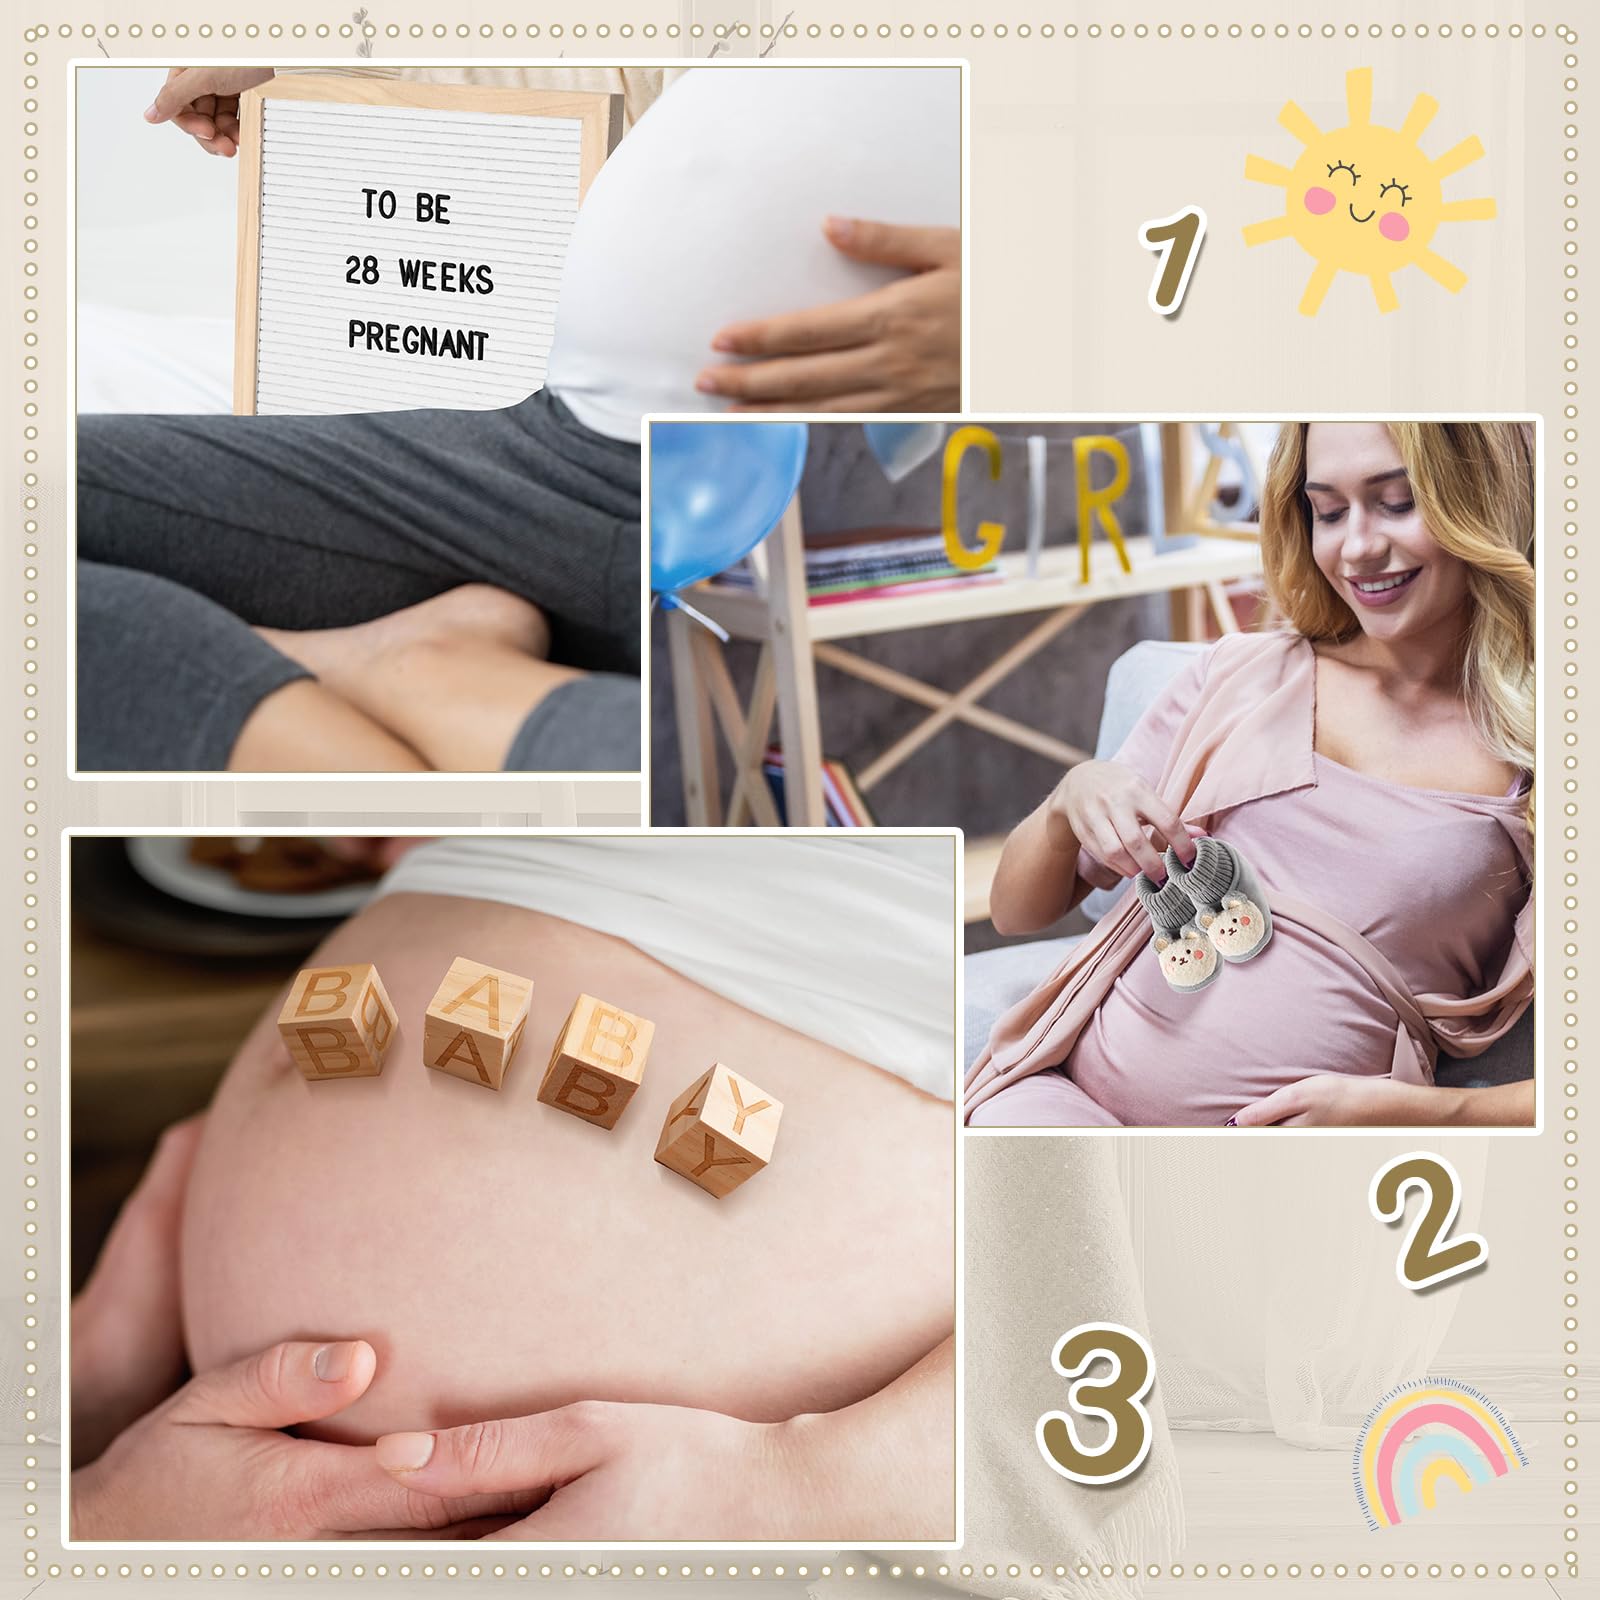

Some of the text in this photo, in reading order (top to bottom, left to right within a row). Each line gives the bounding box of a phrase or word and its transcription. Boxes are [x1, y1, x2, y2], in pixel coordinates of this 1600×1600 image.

[361, 188, 451, 225] TO BE
[345, 255, 494, 294] 28 WEEKS
[348, 319, 489, 361] PREGNANT
